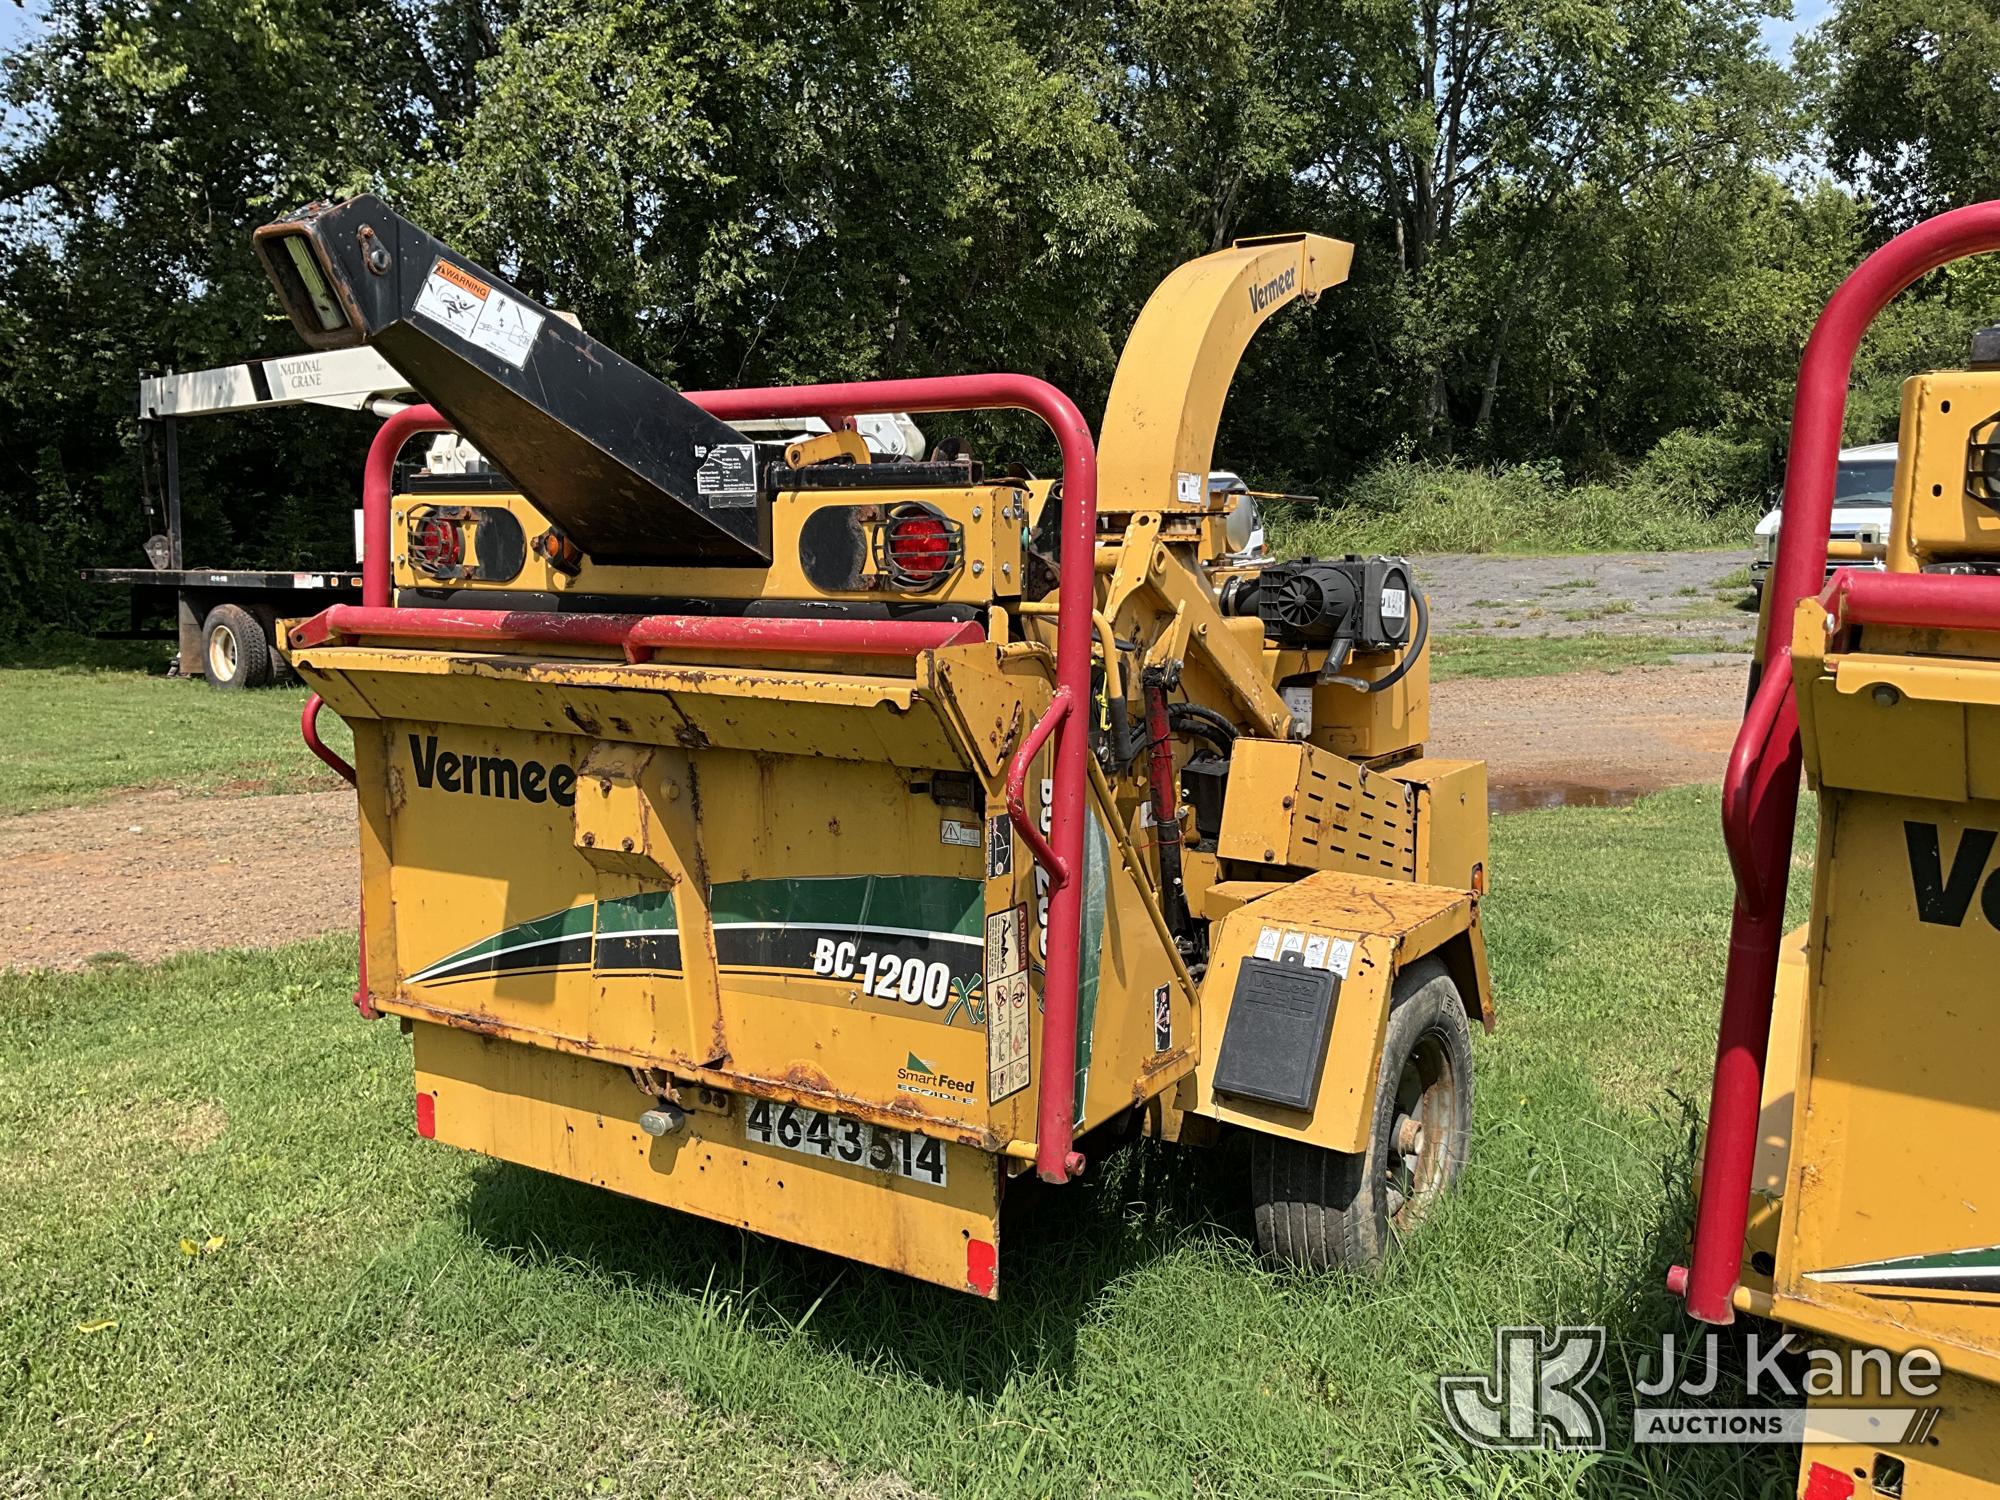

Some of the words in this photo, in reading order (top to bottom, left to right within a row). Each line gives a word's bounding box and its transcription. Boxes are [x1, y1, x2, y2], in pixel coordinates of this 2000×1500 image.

[446, 269, 487, 297] WARNING
[1249, 267, 1295, 314] Vermeer
[280, 360, 321, 376] NATIONAL
[291, 374, 321, 388] CRANE
[408, 734, 577, 807] Vermee
[813, 937, 857, 979] BC
[859, 951, 951, 1009] 1200
[748, 1099, 944, 1184] 4643514
